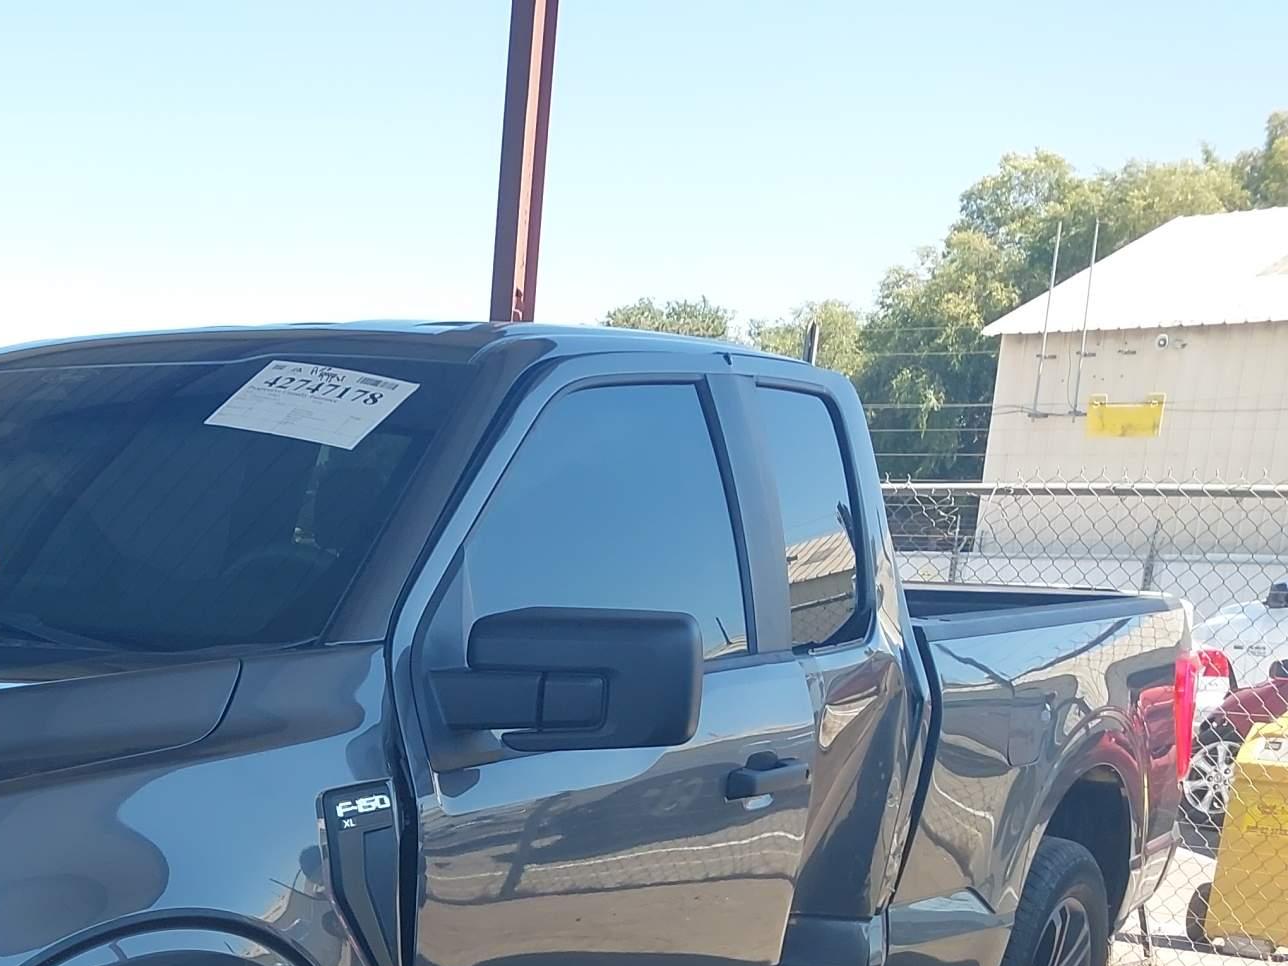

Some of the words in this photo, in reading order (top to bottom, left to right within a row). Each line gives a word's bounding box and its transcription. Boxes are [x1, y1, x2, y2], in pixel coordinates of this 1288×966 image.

[264, 376, 383, 406] 42747178
[336, 795, 391, 817] F-150
[342, 818, 356, 829] XL
